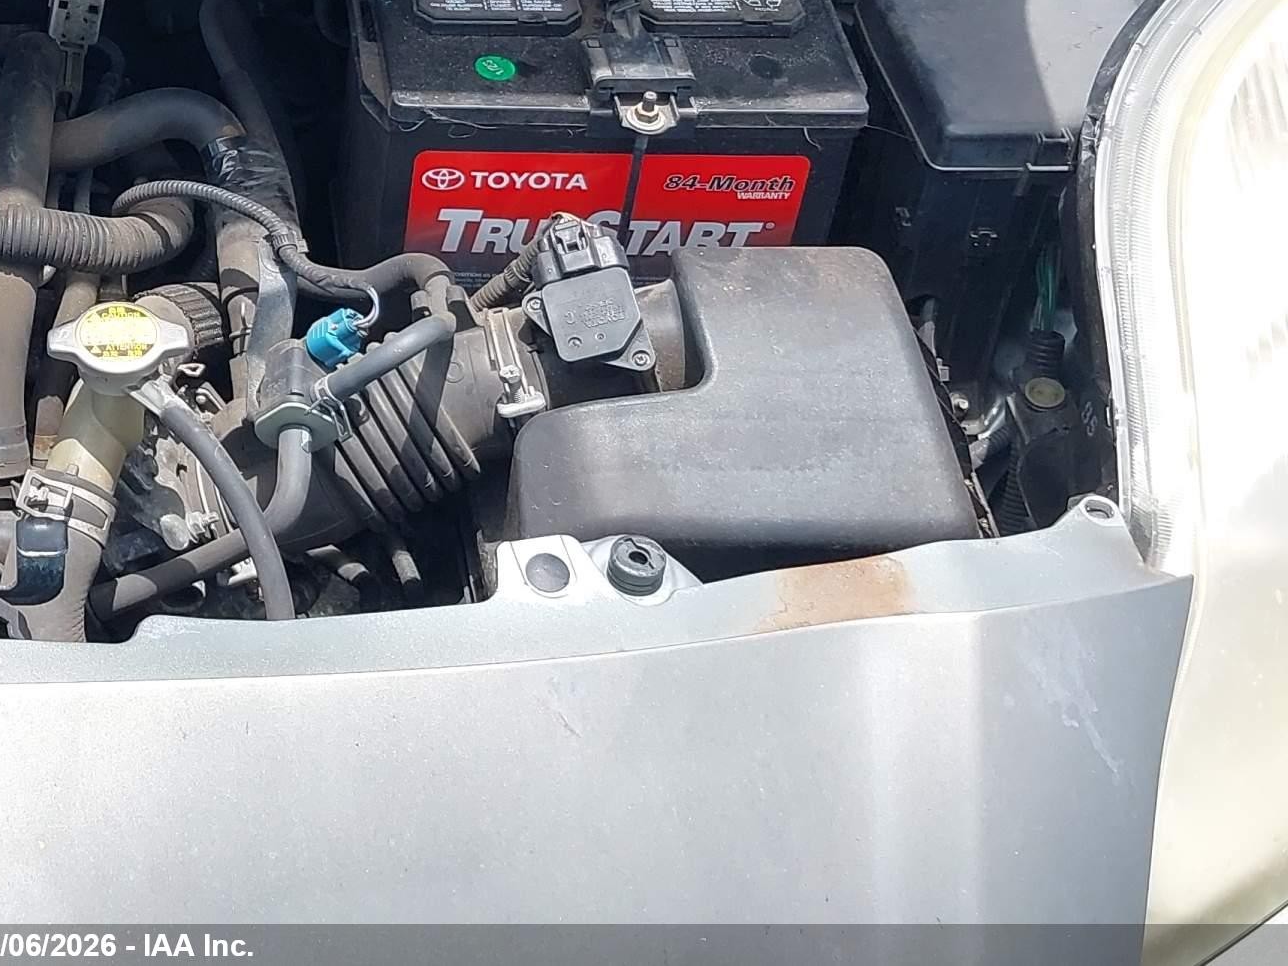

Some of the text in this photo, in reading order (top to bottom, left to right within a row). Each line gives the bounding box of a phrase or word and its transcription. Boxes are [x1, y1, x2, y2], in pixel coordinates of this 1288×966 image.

[470, 171, 588, 191] TOYOTA
[664, 174, 795, 191] 84-Month
[737, 192, 791, 200] WARRANTY
